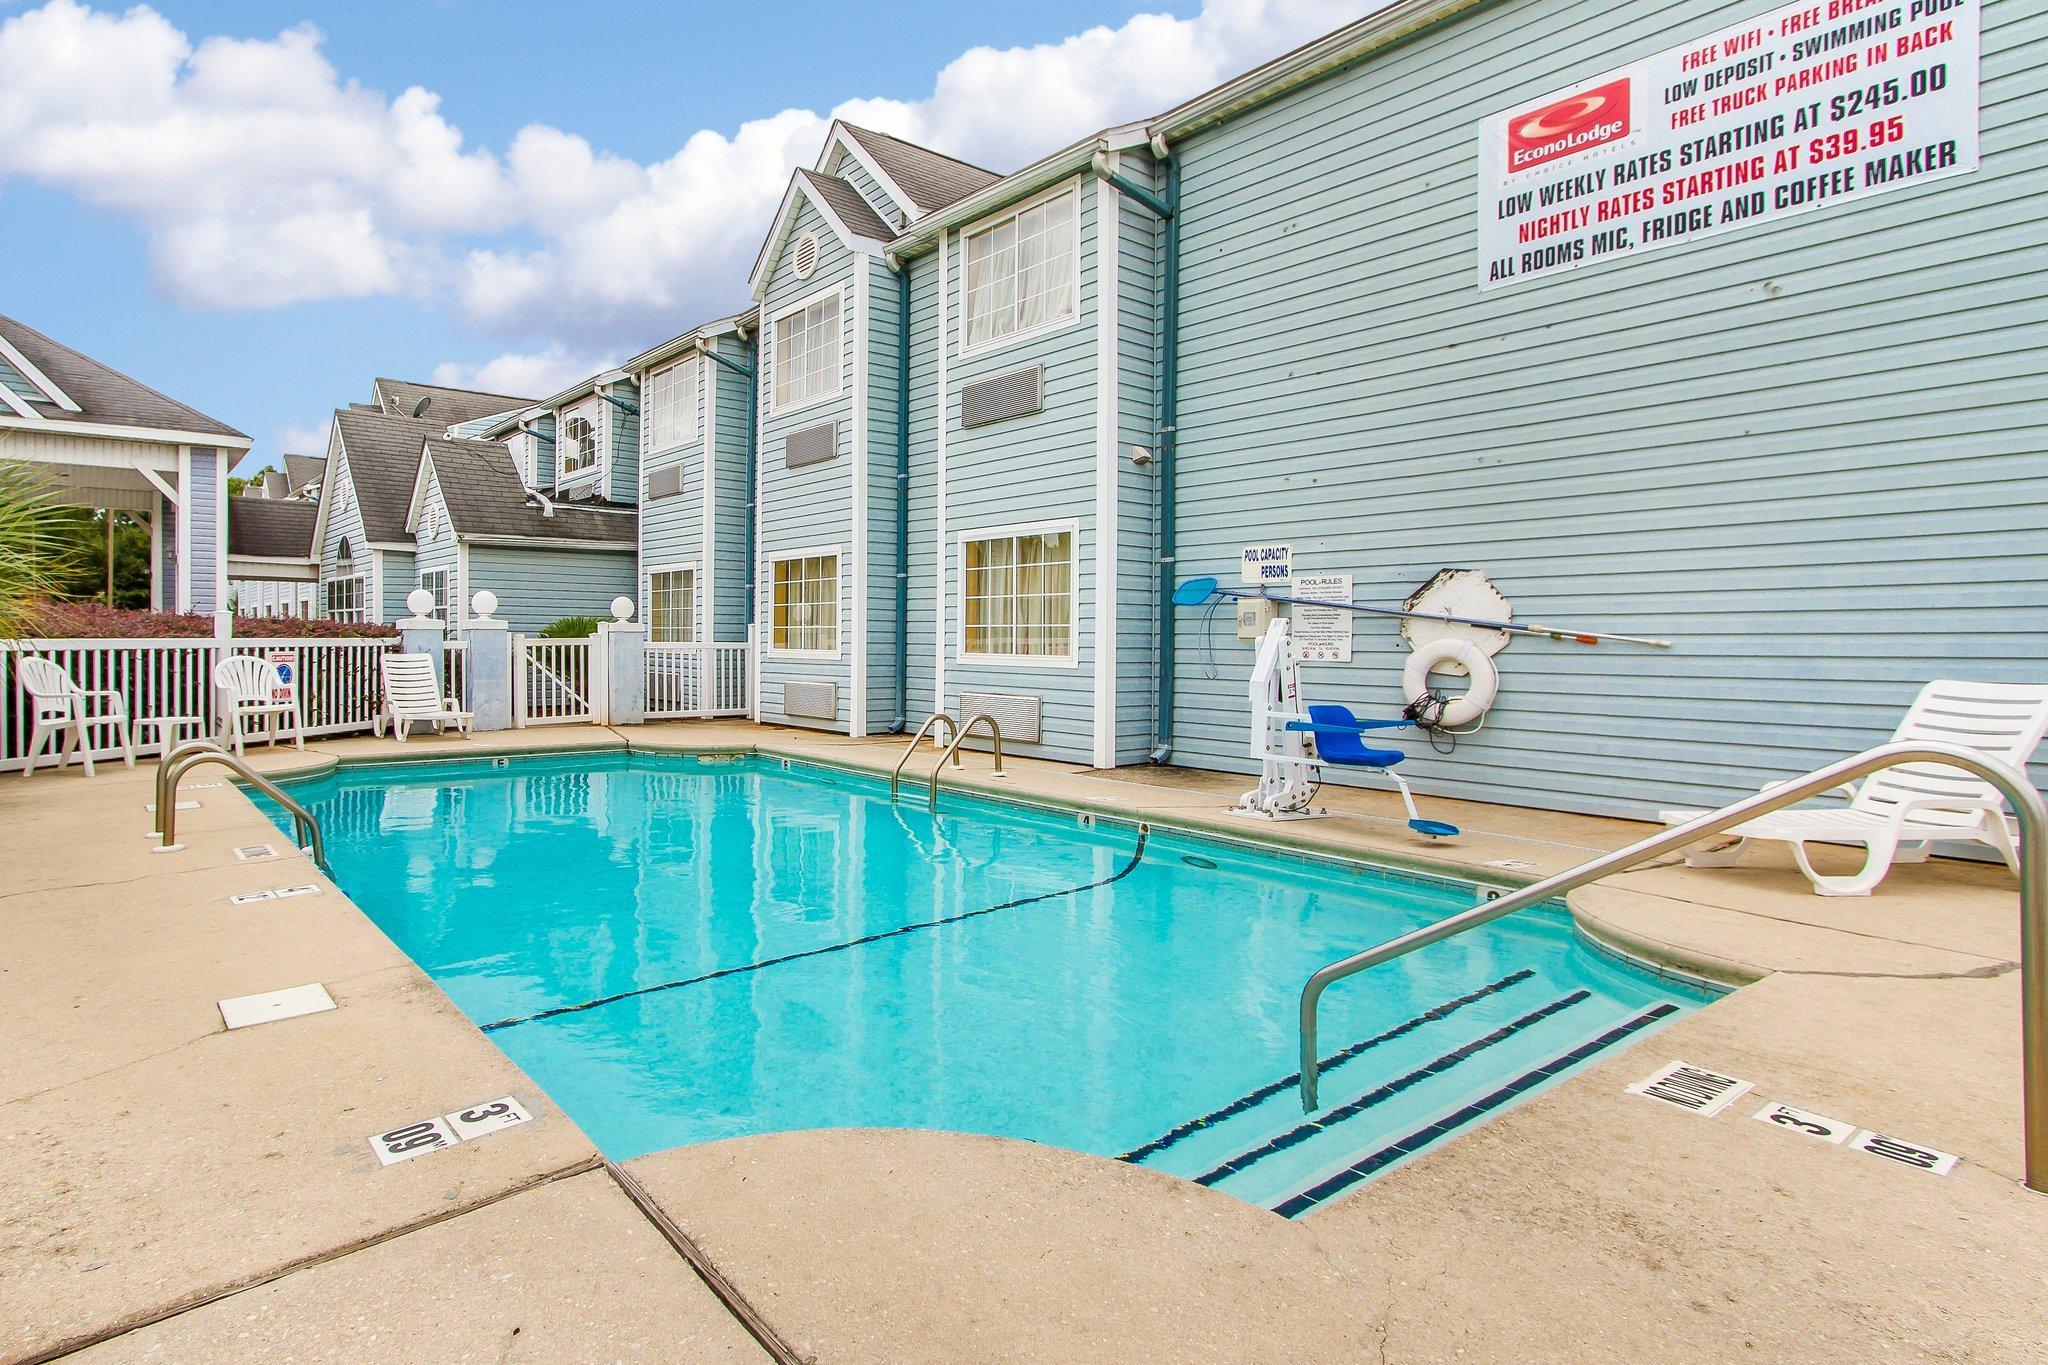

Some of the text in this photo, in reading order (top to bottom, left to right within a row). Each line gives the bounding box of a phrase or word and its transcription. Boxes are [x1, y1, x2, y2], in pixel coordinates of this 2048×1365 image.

[1664, 78, 1698, 105] LOW
[1704, 52, 1775, 92] DEPOSIT
[1792, 8, 1901, 62] SWIMMING
[1682, 44, 1717, 72] FREE
[1724, 28, 1762, 57] WIFI
[1781, 6, 1821, 37] FREE
[1671, 20, 1953, 130] FREE TRUCK PARKING IN BACK
[1498, 63, 1947, 220] LOW WEEKLY RATES STARTING AT $245.00
[1489, 140, 1956, 282] ALL ROOMS MIC, FRIDGE AND COFFEE MAKER
[1518, 115, 1903, 244] NIGHTLY RATES STARTING AT $39.95
[1244, 547, 1289, 562] POOL CAPACITY
[1261, 565, 1289, 578] PERSONS
[1321, 577, 1343, 585] RULES
[460, 1102, 510, 1123] 3
[1769, 1114, 1832, 1136] 3
